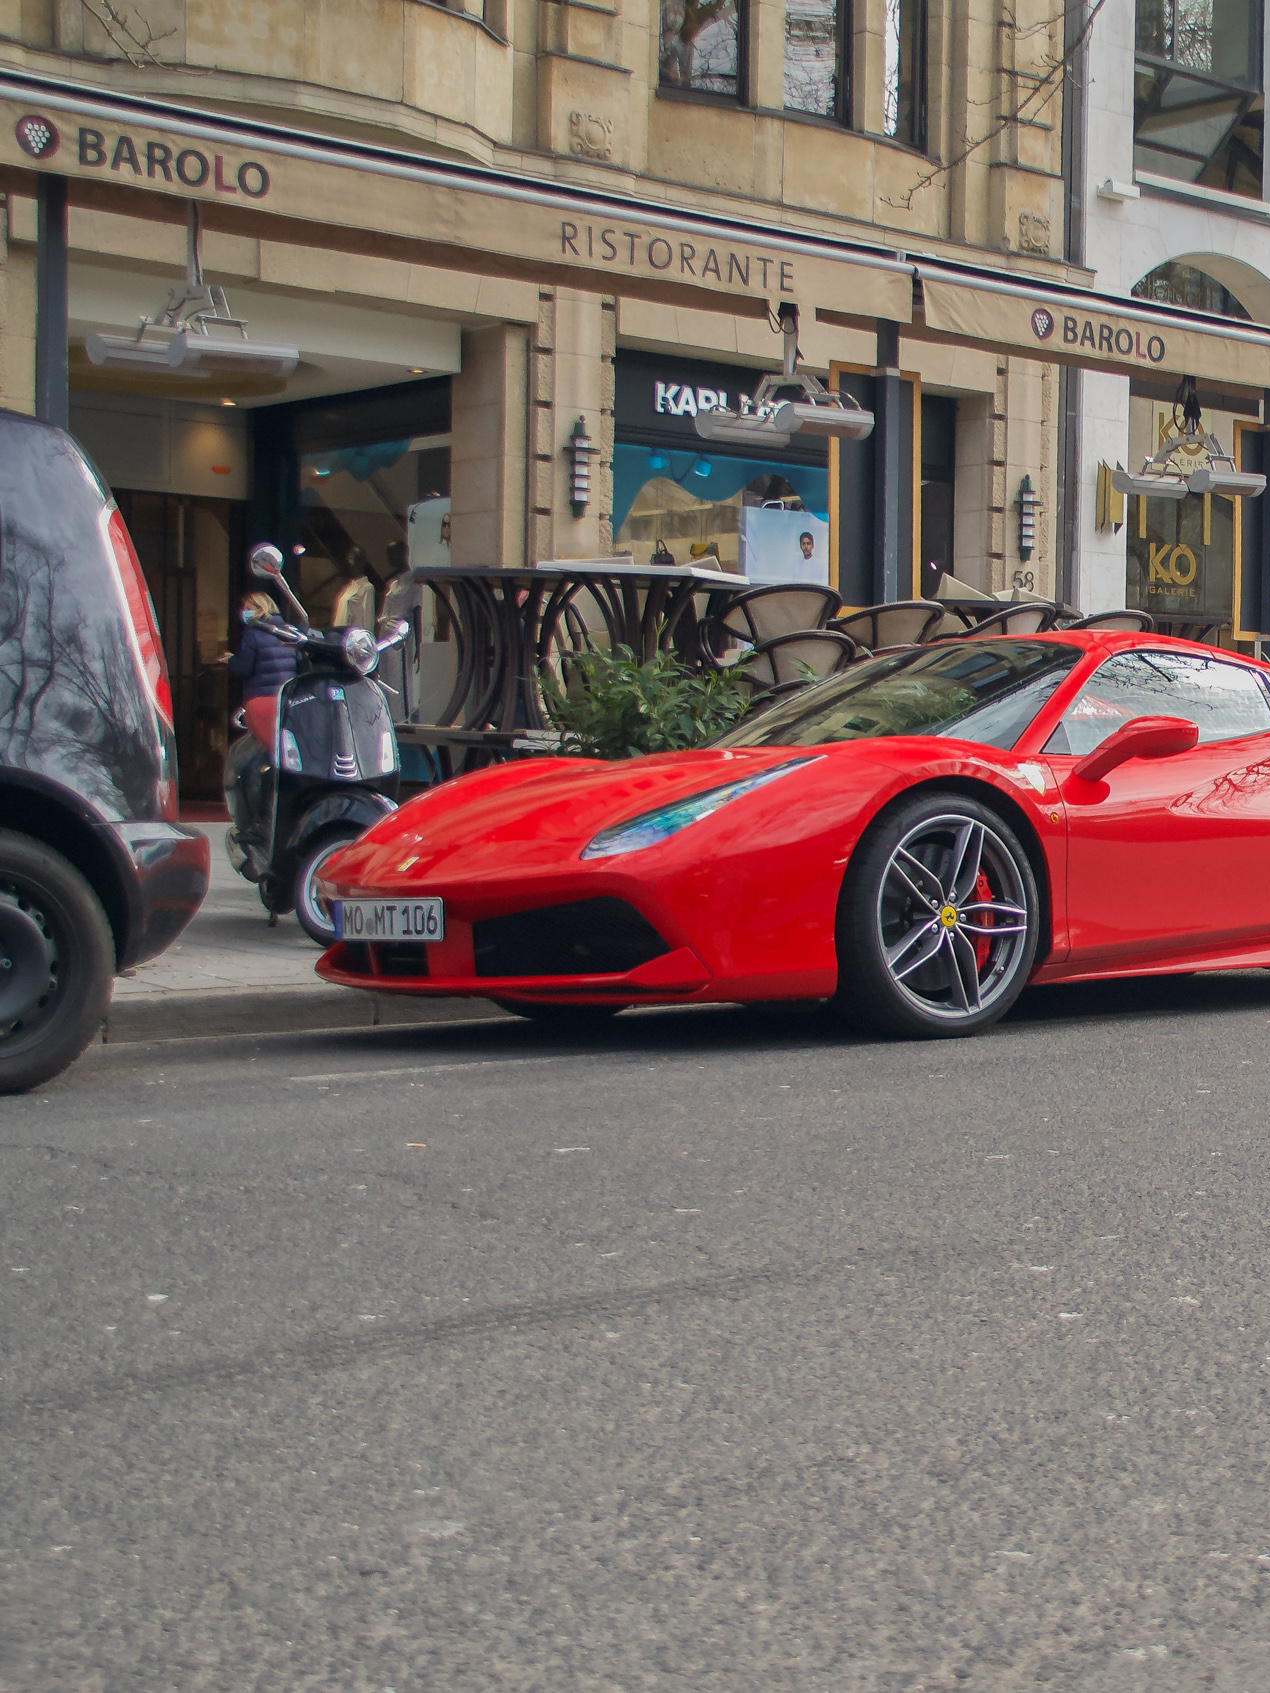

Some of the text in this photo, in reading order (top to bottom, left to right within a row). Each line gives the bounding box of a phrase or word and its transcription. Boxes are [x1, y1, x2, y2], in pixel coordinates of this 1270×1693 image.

[77, 126, 272, 200] BAROLO
[560, 221, 795, 293] RISTORANTE
[1063, 315, 1166, 364] BAROLO
[1012, 570, 1034, 593] 58
[1149, 585, 1196, 598] GALERIE
[374, 905, 397, 935] MT
[401, 904, 438, 936] 106
